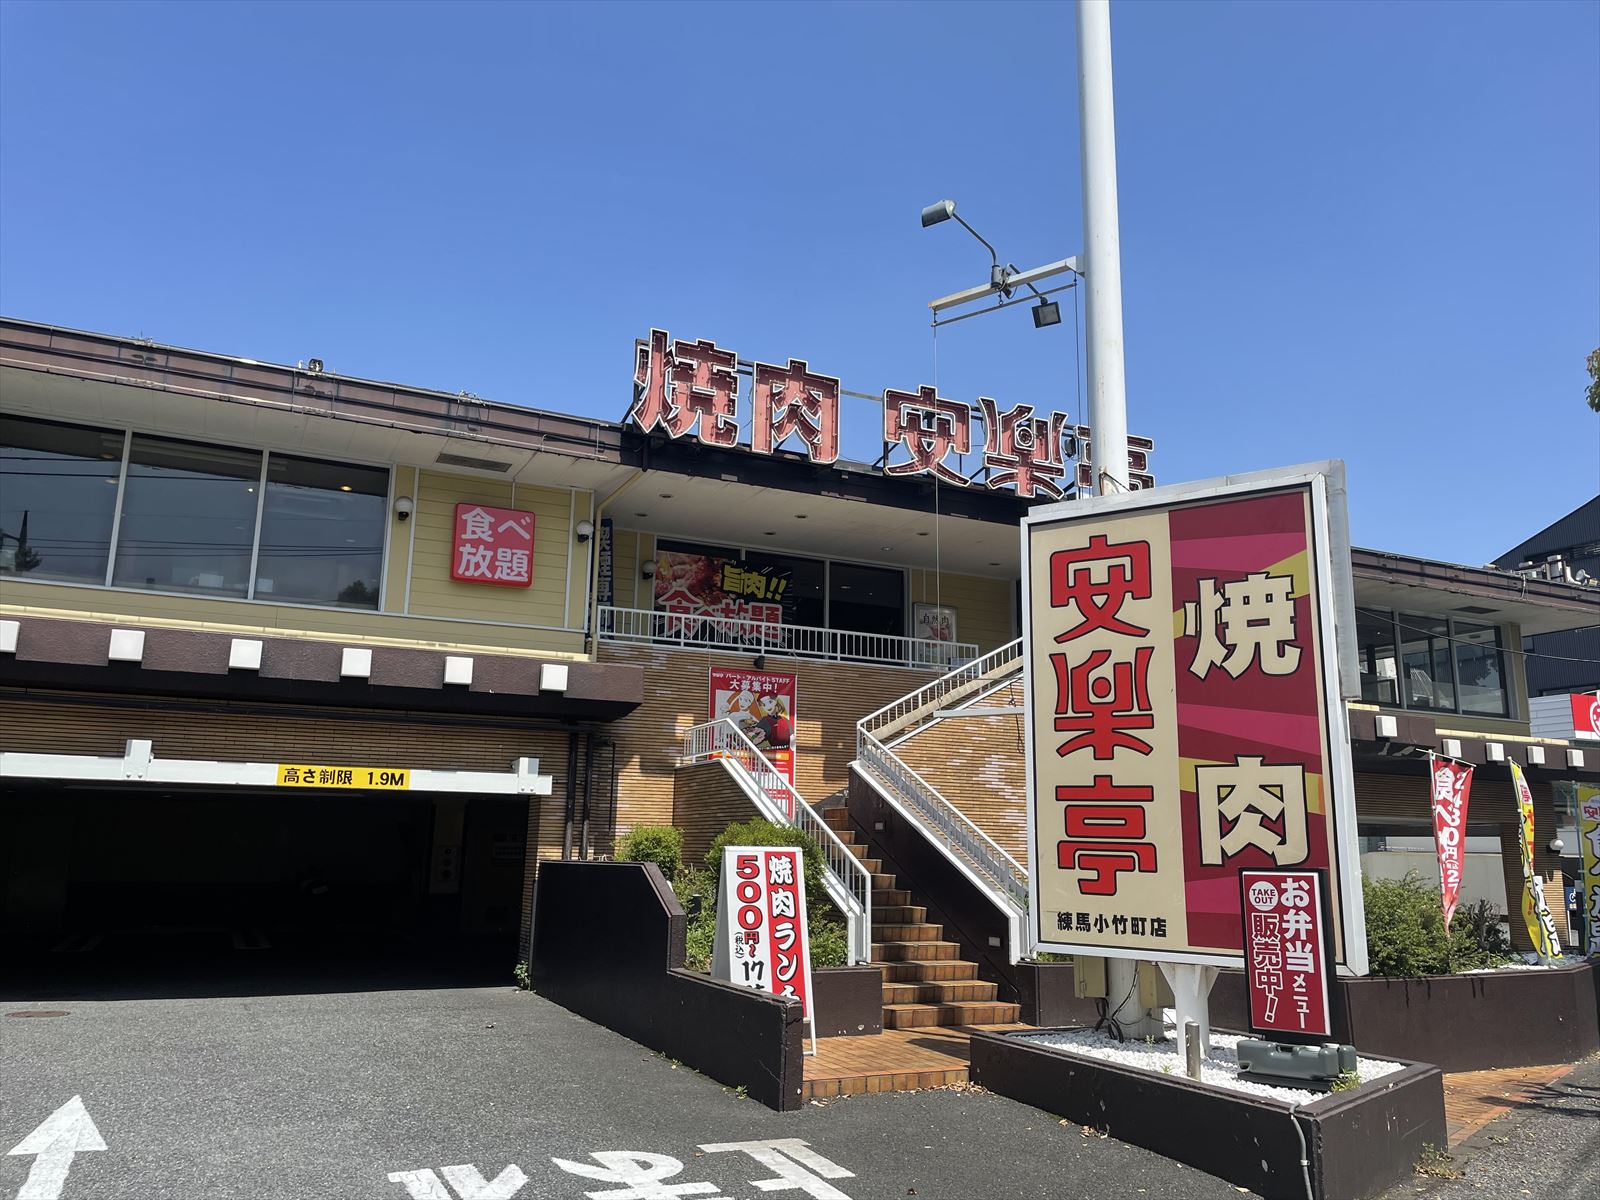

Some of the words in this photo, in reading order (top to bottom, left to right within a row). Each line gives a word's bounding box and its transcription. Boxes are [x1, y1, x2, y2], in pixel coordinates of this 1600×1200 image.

[632, 328, 840, 464] 焼肉
[461, 507, 531, 542] 食べ
[458, 543, 530, 582] 放題
[722, 563, 787, 601] 旨肉!!
[729, 679, 777, 693] 大募集中!
[771, 677, 791, 685] STAFF
[1049, 534, 1159, 898] 安楽亭
[1183, 571, 1309, 868] 焼肉
[283, 768, 353, 785] 高さ制限
[367, 771, 405, 786] 1.9M
[1251, 888, 1276, 897] TAKE
[1254, 896, 1274, 905] OUT
[1057, 911, 1167, 938] 練馬小竹町店
[1251, 912, 1284, 1023] 販売中!
[1280, 877, 1315, 1029] お弁当メニュー
[742, 960, 765, 989] 17
